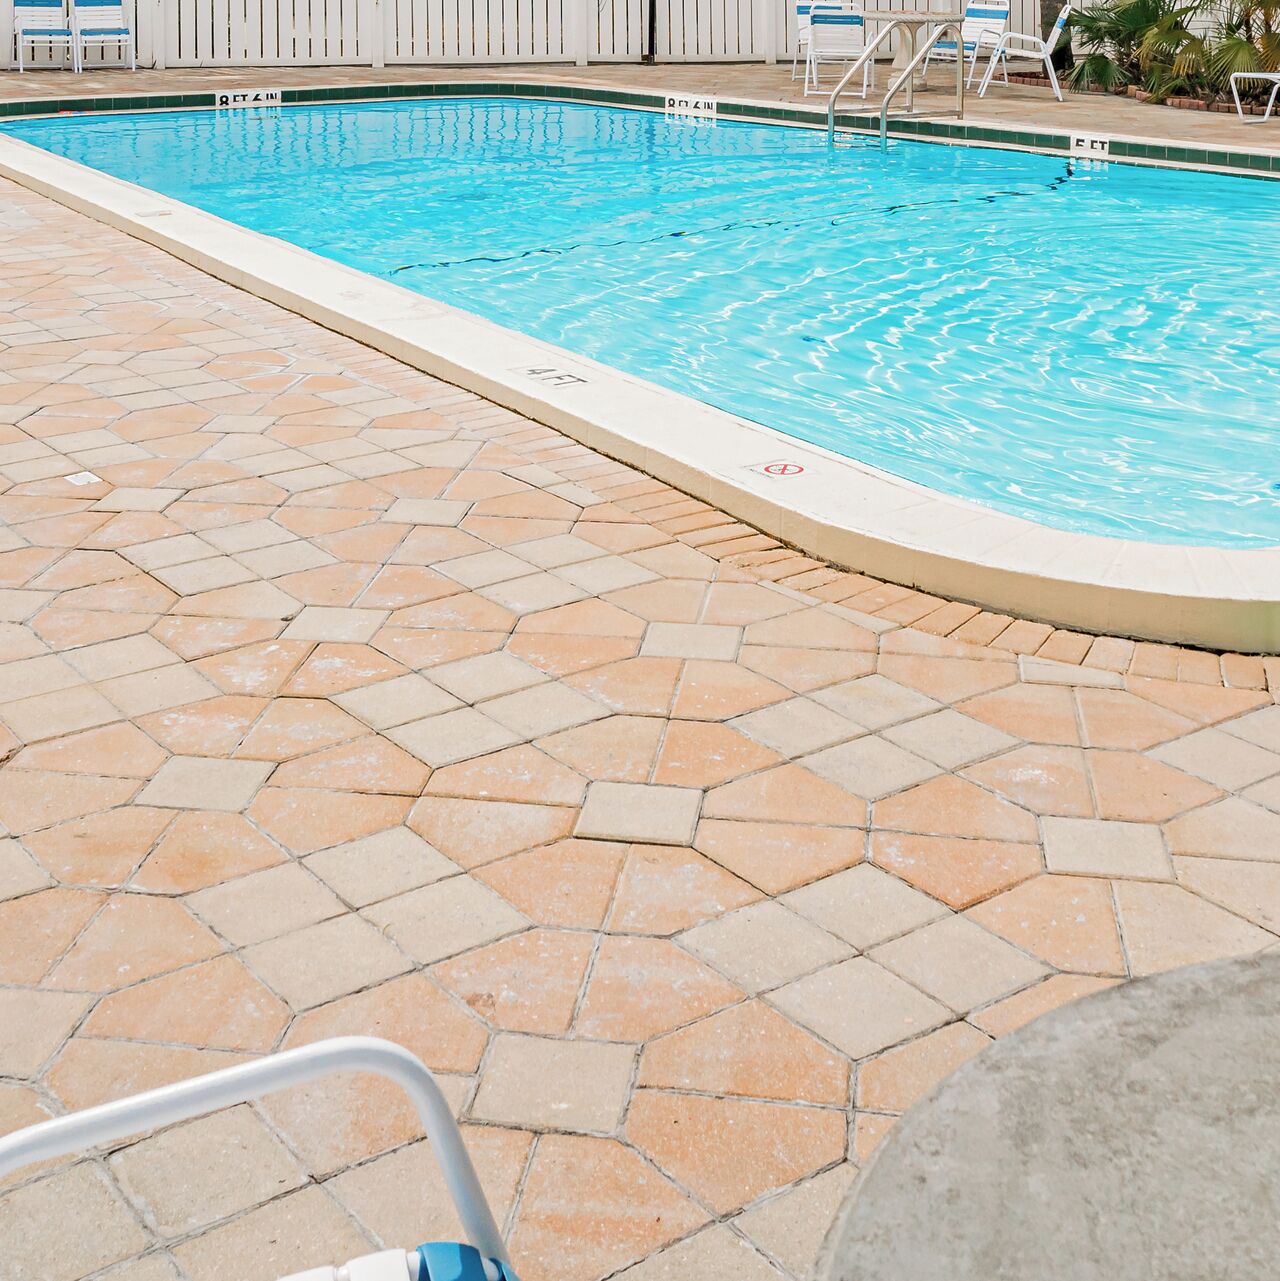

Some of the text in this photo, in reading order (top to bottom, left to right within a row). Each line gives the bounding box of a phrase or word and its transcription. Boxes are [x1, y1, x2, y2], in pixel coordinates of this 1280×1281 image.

[219, 94, 229, 106] 8
[668, 97, 676, 108] 8
[526, 368, 589, 386] 4 FT
